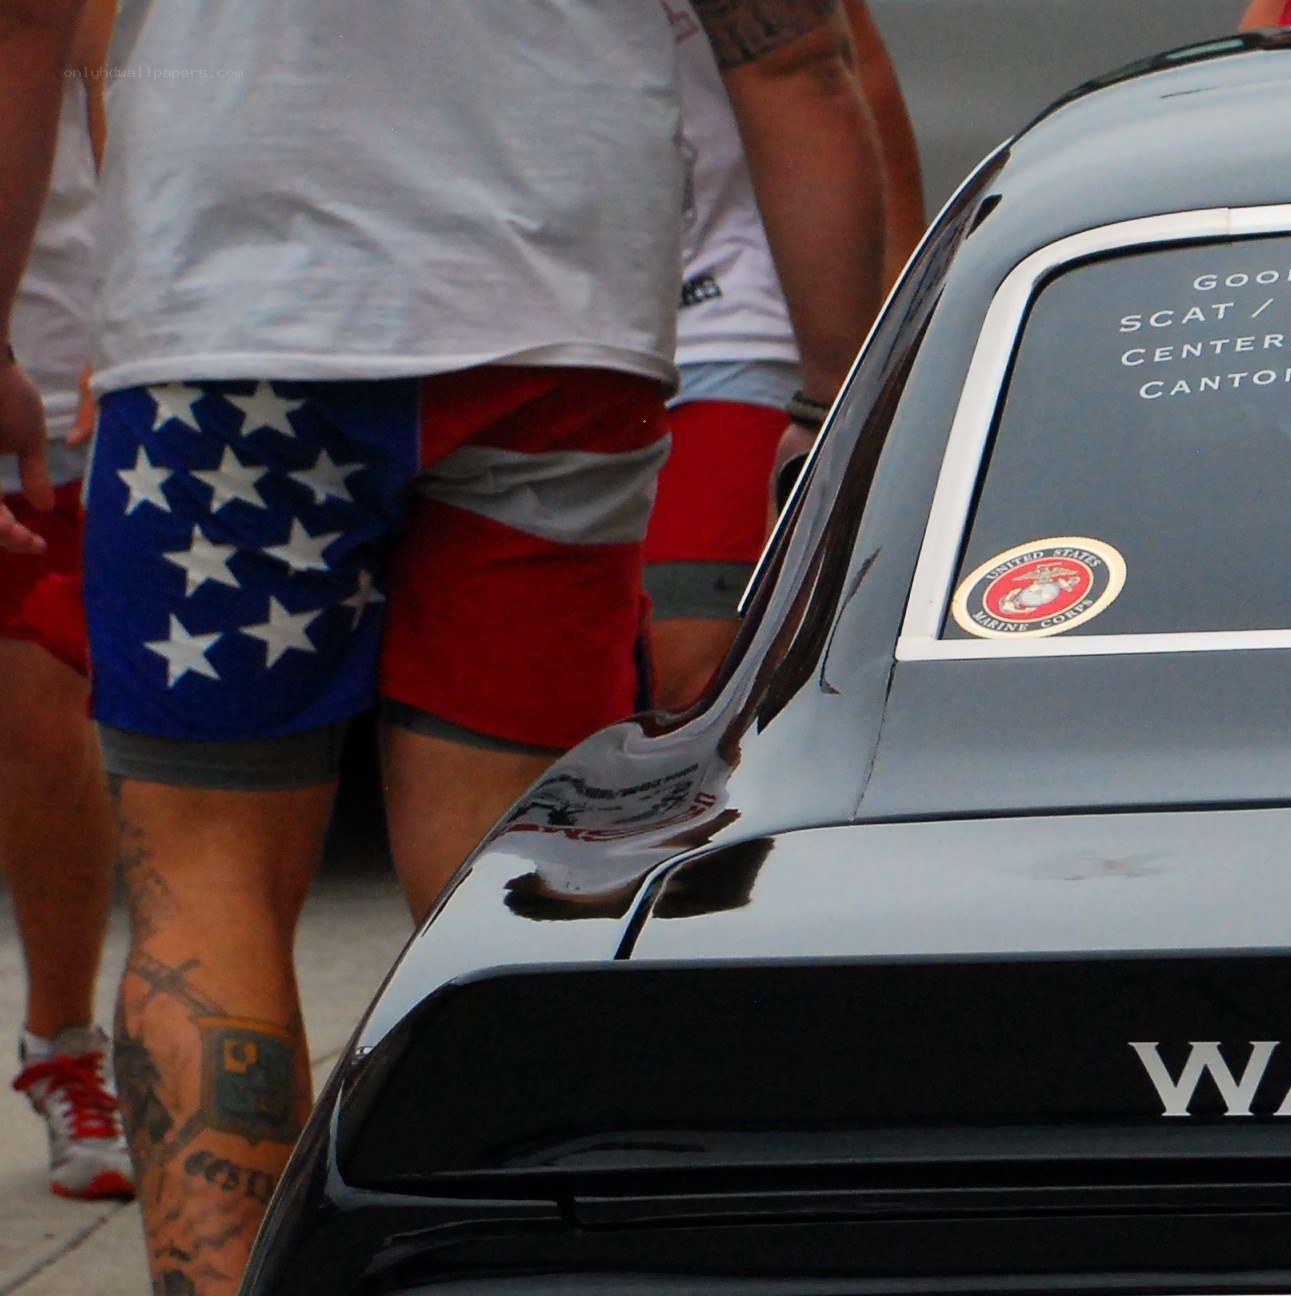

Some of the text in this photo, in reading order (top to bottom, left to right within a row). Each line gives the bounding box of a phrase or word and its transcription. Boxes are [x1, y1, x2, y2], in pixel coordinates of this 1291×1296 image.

[1119, 301, 1235, 333] SCAT
[986, 548, 1103, 580] UNITED STATES
[972, 598, 1093, 632] MARINE CORPS
